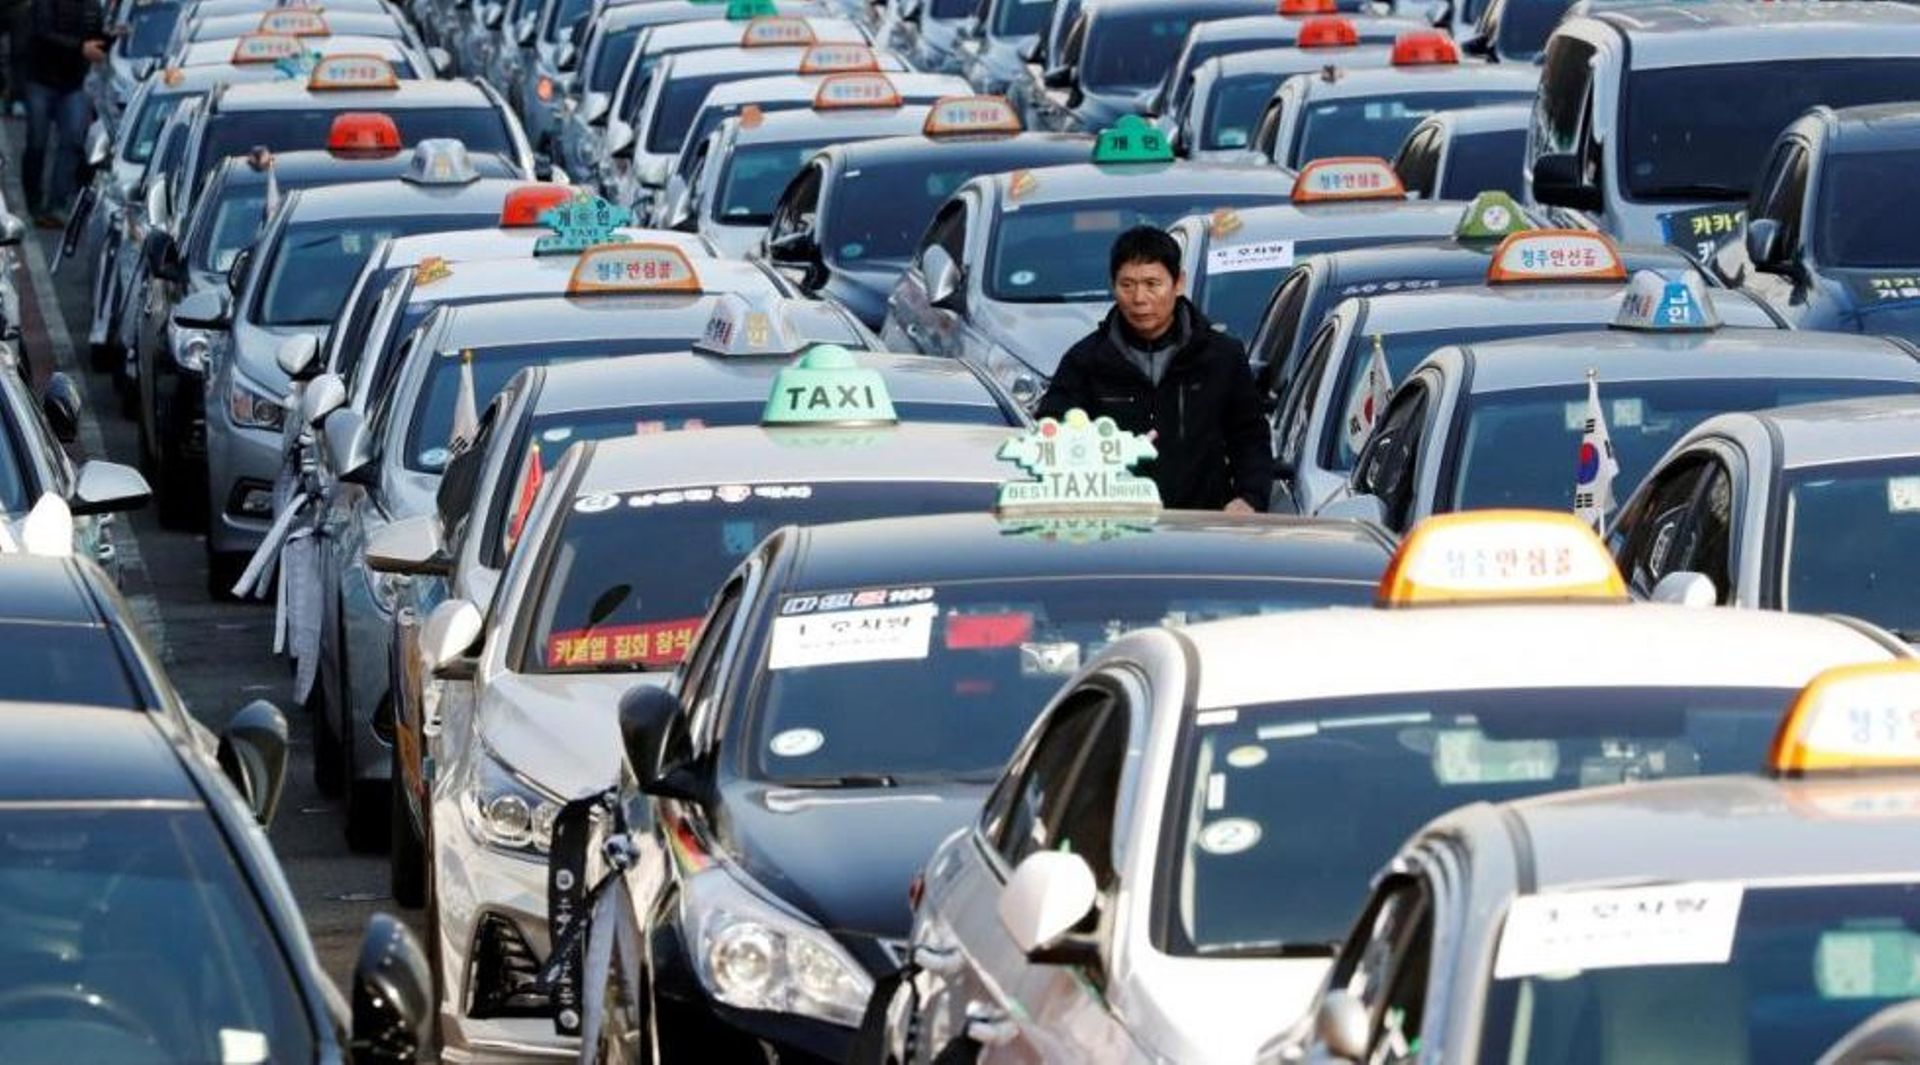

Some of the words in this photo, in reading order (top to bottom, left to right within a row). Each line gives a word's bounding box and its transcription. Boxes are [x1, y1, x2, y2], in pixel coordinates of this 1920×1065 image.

[786, 385, 874, 410] TAXI
[1009, 485, 1049, 498] BEST
[1051, 472, 1108, 498] TAXI
